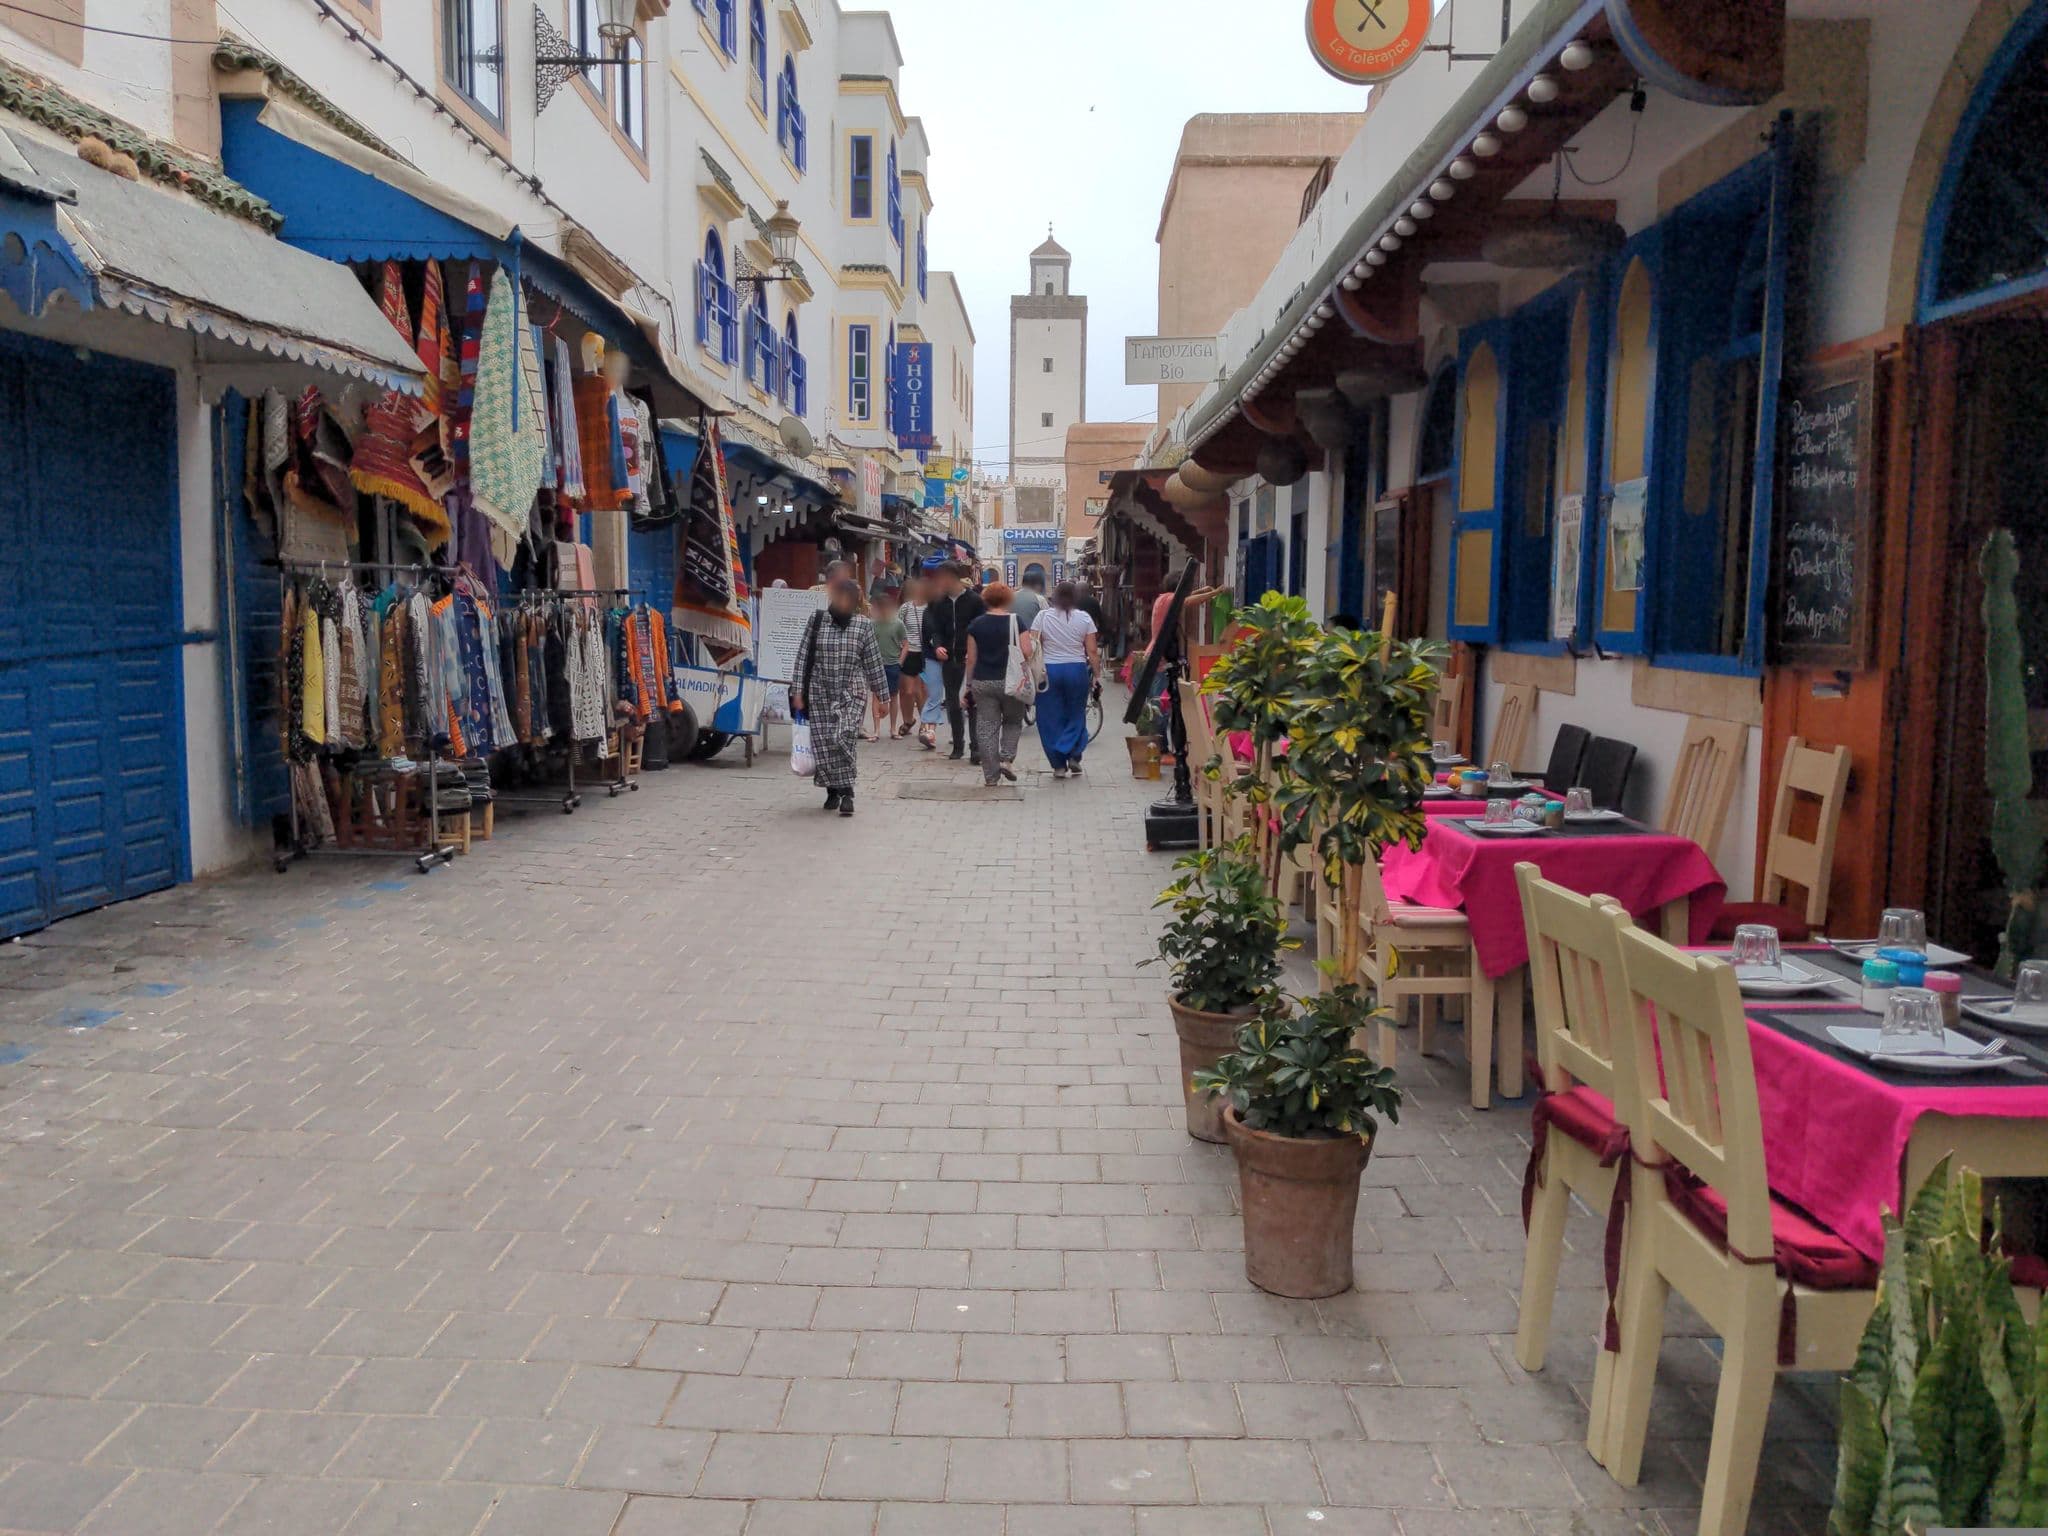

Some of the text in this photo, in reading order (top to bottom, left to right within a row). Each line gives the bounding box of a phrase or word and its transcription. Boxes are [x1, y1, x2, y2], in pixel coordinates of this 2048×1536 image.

[1329, 38, 1411, 64] La Tolérance
[906, 364, 922, 432] HOTEL
[1004, 530, 1065, 539] CHANGE
